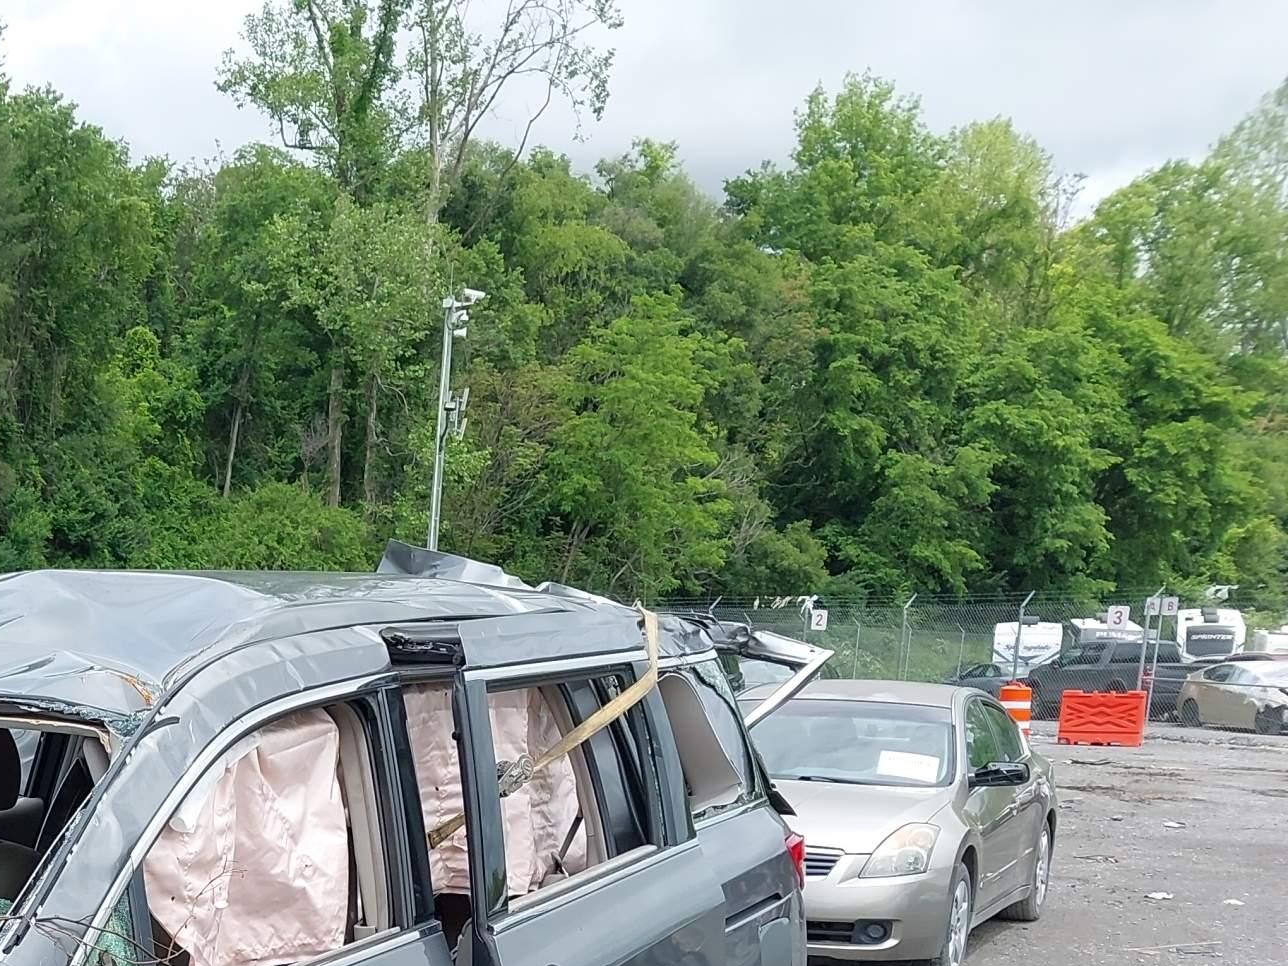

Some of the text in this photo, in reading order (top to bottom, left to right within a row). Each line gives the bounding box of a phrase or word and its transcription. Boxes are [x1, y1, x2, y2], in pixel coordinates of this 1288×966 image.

[1167, 601, 1174, 611] B
[815, 613, 824, 627] 2
[1113, 610, 1123, 625] 3
